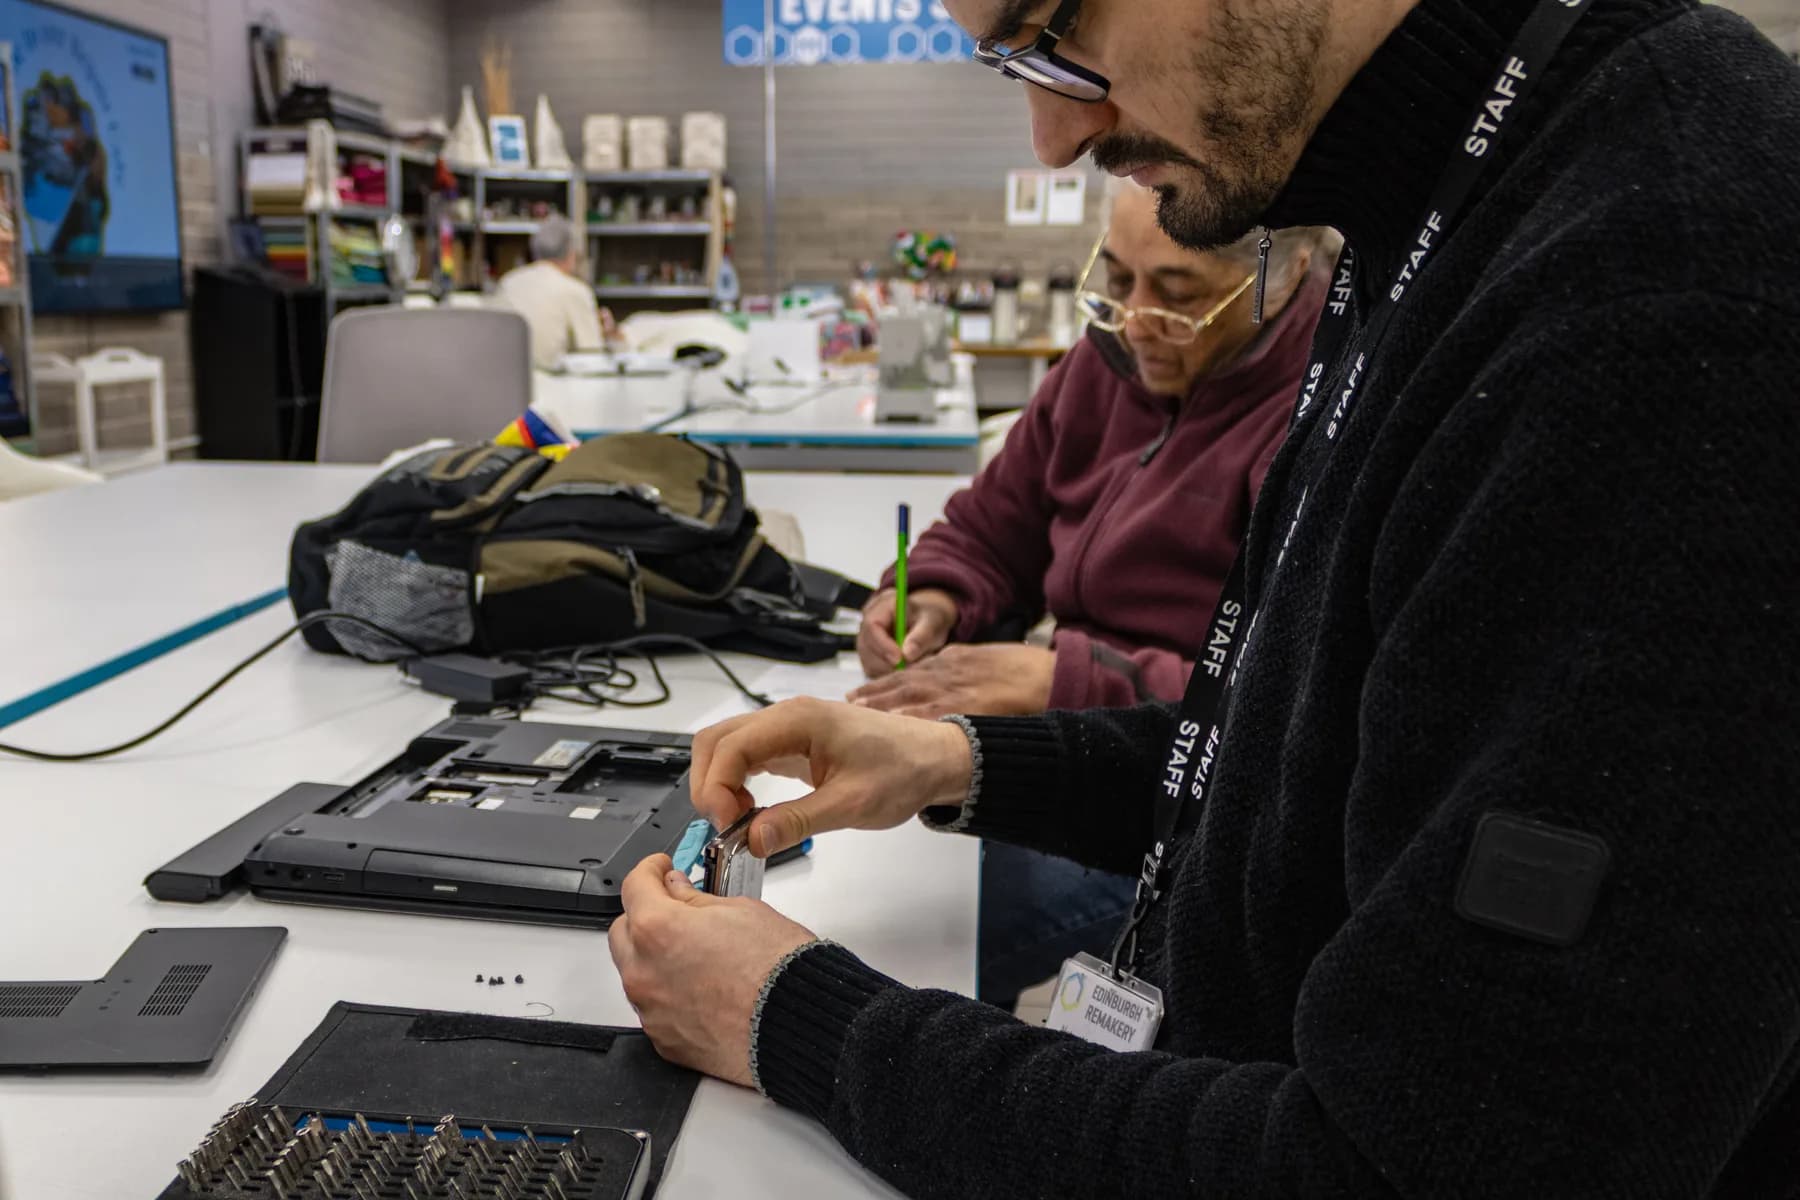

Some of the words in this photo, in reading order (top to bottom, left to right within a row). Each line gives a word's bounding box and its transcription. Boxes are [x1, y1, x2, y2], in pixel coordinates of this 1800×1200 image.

[780, 0, 922, 23] EVENTS
[1464, 55, 1528, 158] STAFF
[1329, 248, 1353, 316] TAFF
[1389, 210, 1443, 302] STAFF
[1326, 352, 1366, 440] STAFF
[1202, 600, 1242, 679] STAFF
[1163, 719, 1201, 798] STAFF
[1191, 724, 1220, 800] STAFF
[1084, 1004, 1137, 1043] REMAKERY
[1092, 985, 1144, 1023] EDINBURGH
